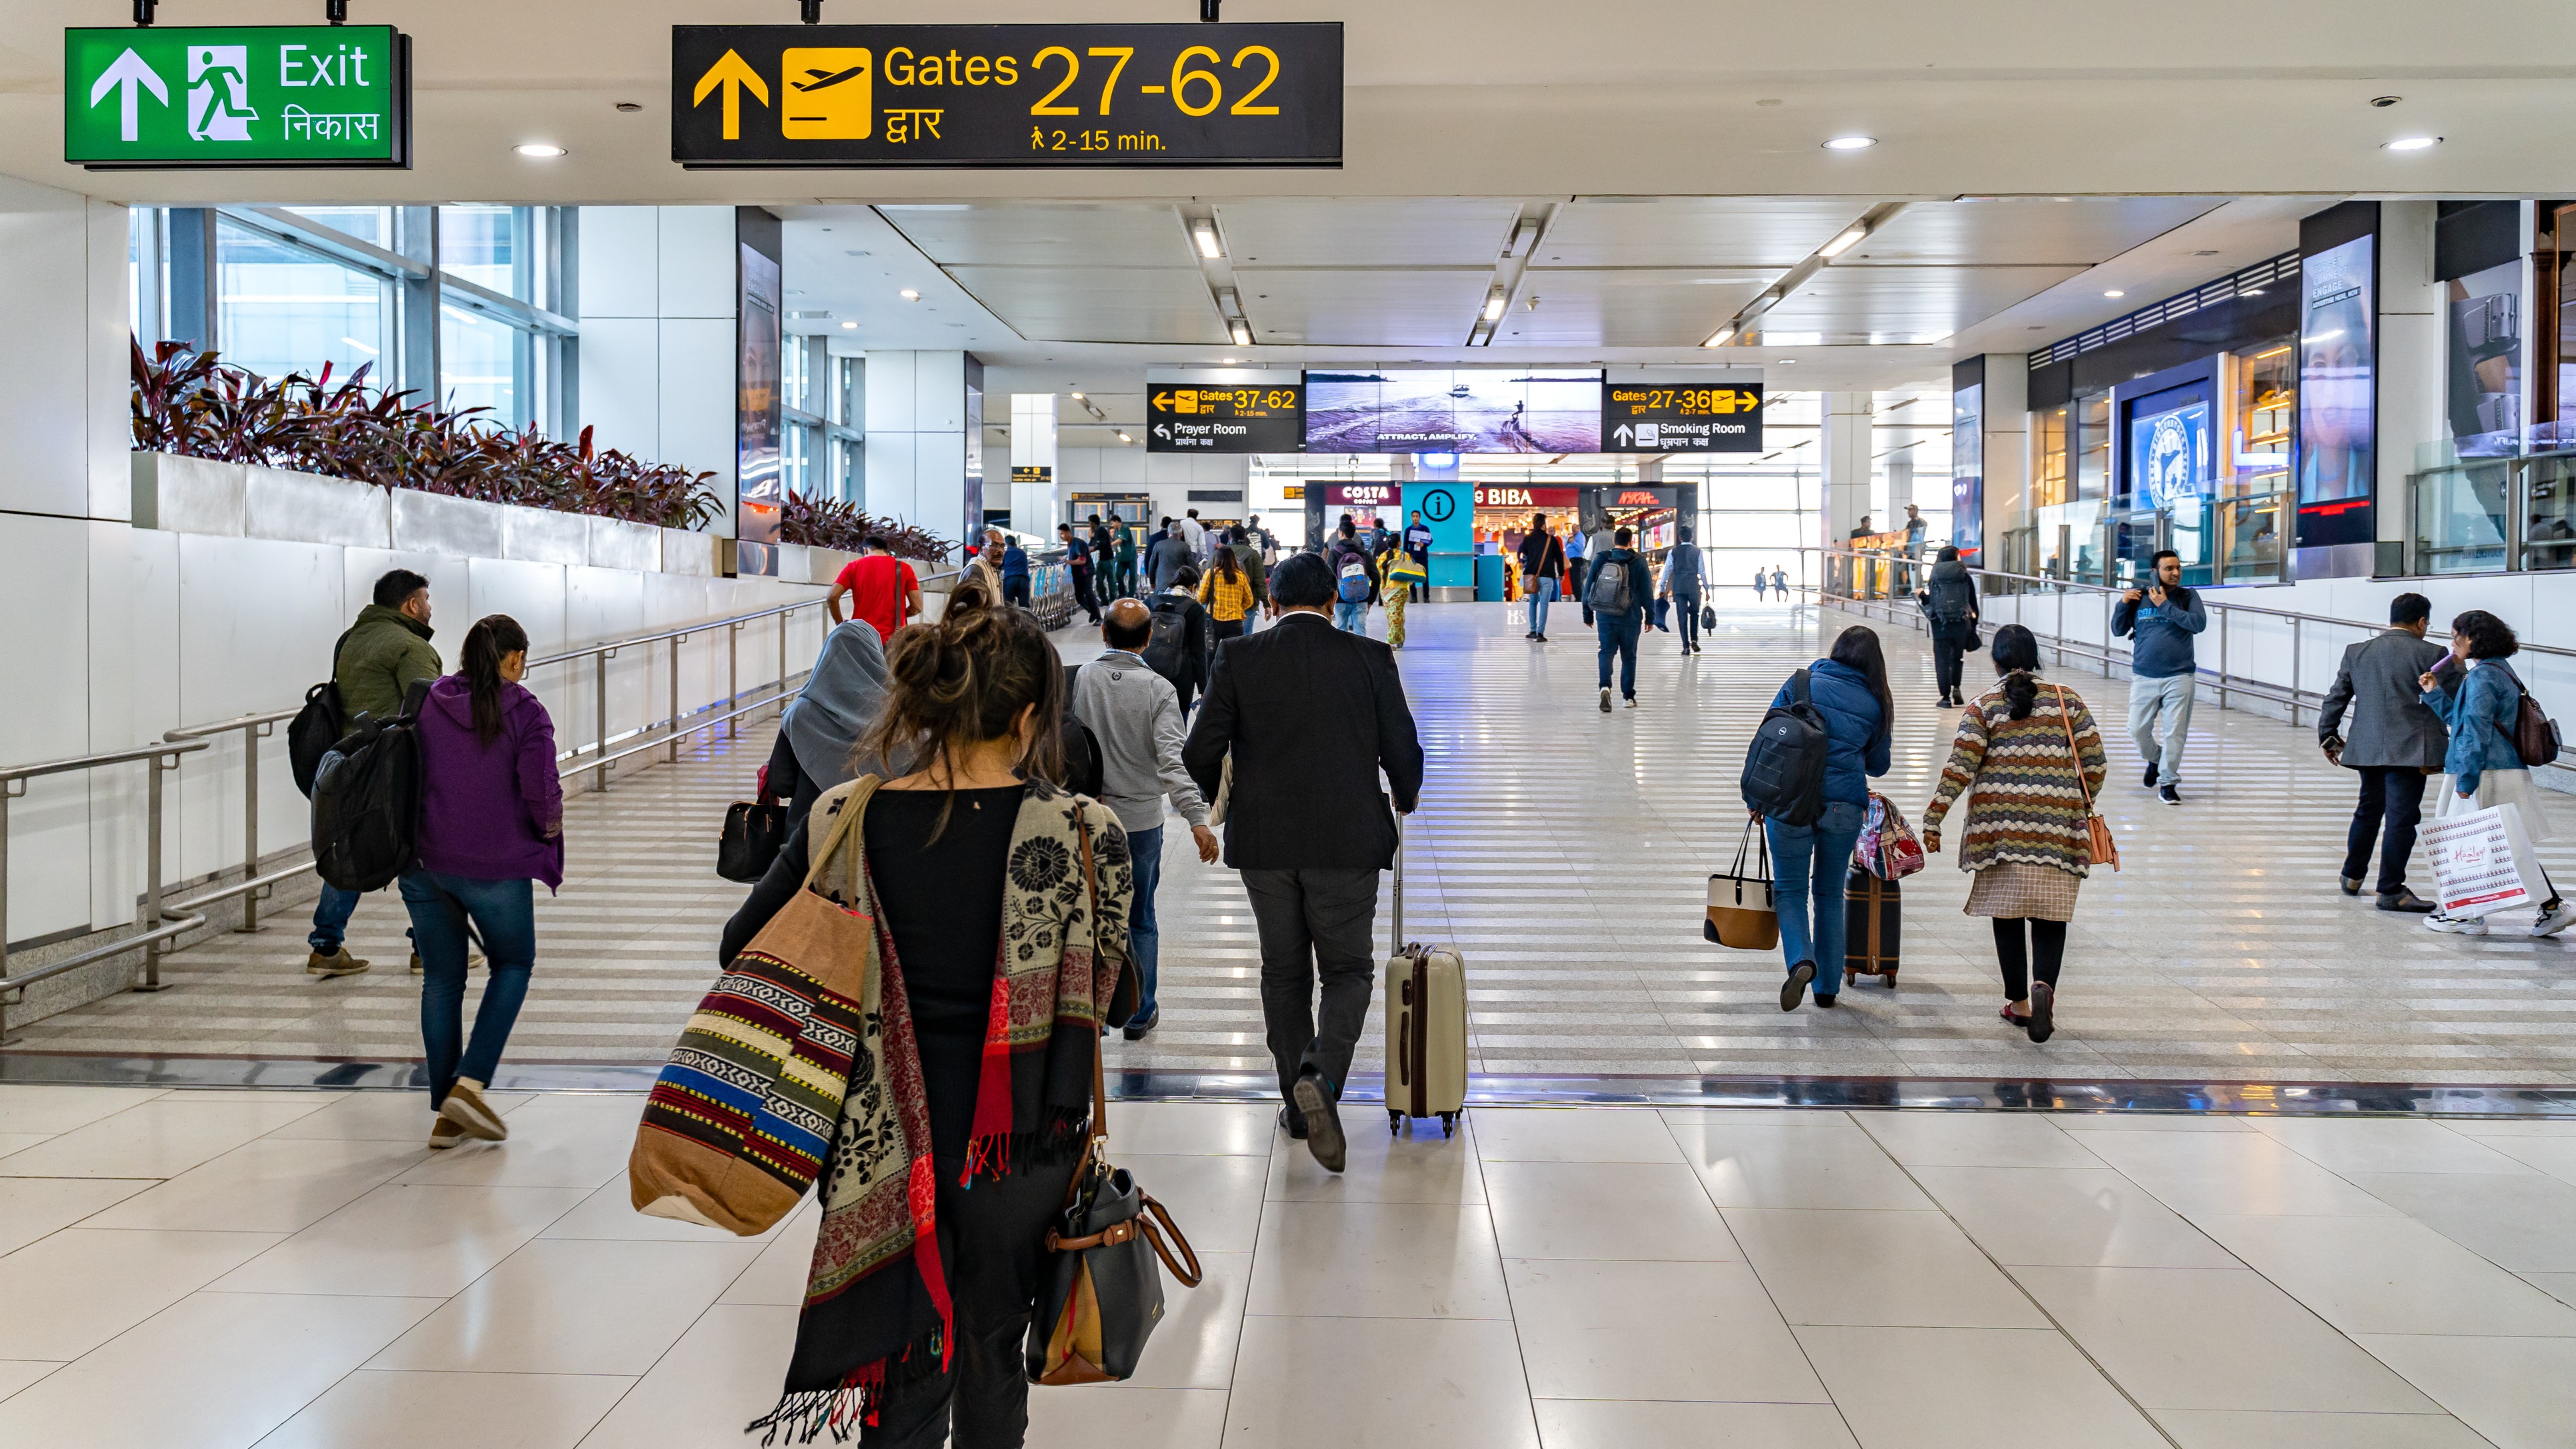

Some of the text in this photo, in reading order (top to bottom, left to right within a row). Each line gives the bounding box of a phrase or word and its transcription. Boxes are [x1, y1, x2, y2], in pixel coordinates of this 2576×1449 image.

[280, 44, 369, 87] Exit
[884, 45, 1279, 117] Gates 27-62
[281, 103, 380, 140] निकास
[883, 109, 944, 143] द्वार
[1051, 130, 1166, 151] 2-15 min.
[2313, 265, 2347, 287] CONNECT
[2313, 280, 2342, 299] ENGAGE
[1199, 389, 1295, 409] Gates 37-62
[1612, 390, 1711, 409] Gates 27-36
[1199, 404, 1215, 415] द्वार
[1631, 405, 1647, 415] द्वार
[1174, 423, 1247, 437] Prayer Room
[1660, 423, 1746, 436] Smoking Room
[1175, 437, 1197, 446] प्रार्थना
[1692, 438, 1709, 447] कक्ष
[1342, 487, 1389, 499] COSTA
[1488, 489, 1533, 505] BIBA
[1618, 491, 1659, 505] NYKAA
[2454, 846, 2486, 863] Hamleys
